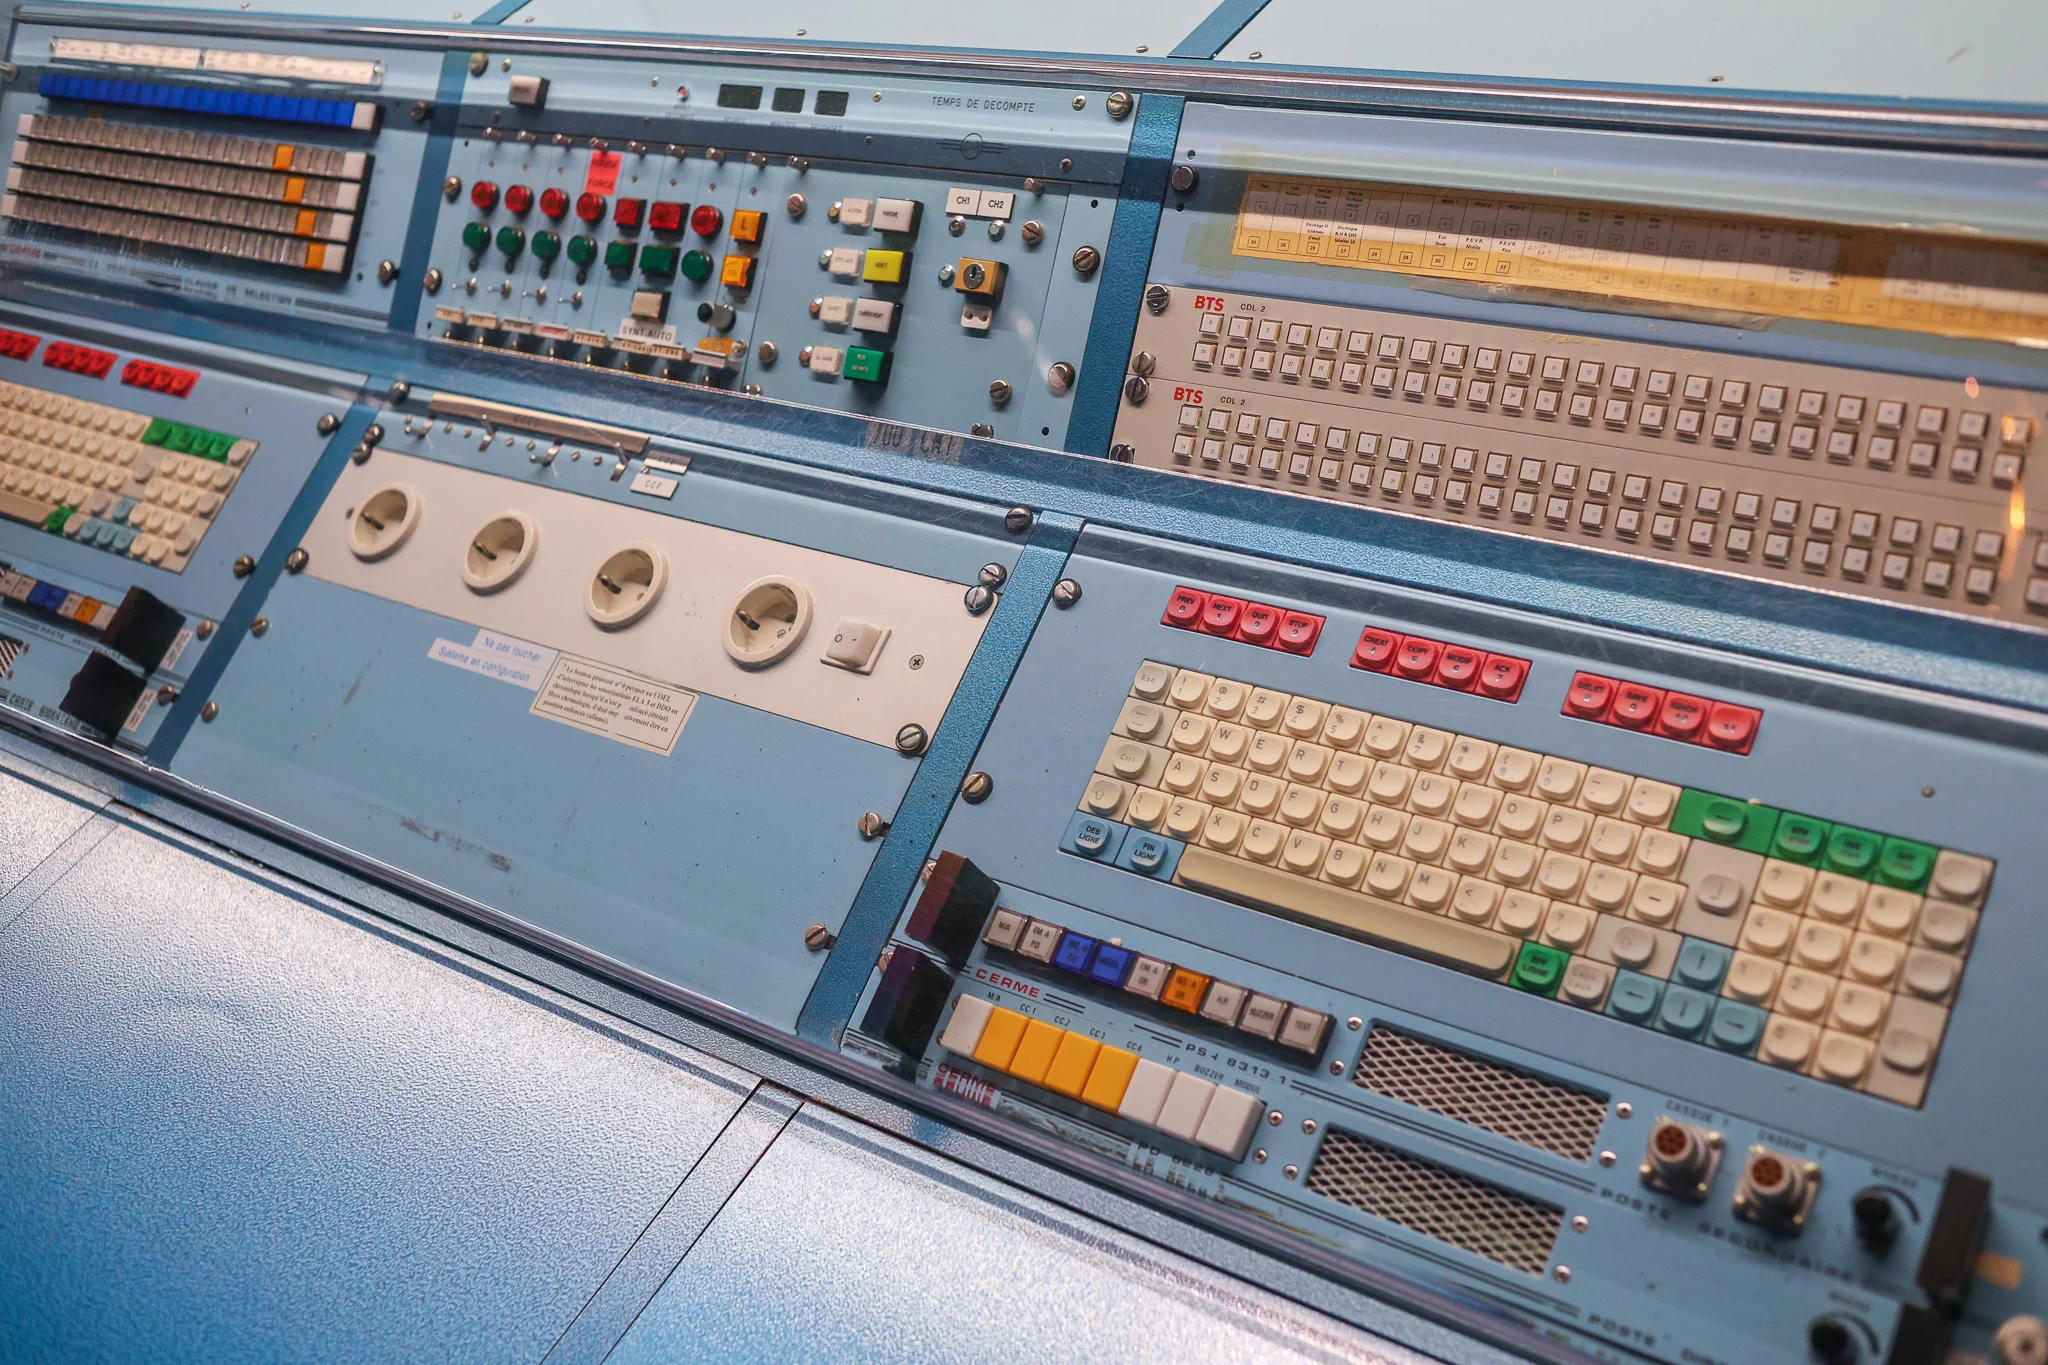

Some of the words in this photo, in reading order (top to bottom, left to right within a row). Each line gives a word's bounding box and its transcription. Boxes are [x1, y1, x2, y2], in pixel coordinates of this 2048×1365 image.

[932, 96, 961, 107] TEMPS
[966, 99, 979, 108] DE
[984, 100, 1035, 112] DECOMPTE
[956, 196, 971, 205] CH1
[988, 200, 1004, 209] CH2
[1194, 295, 1224, 312] BTS
[1240, 303, 1256, 312] CDL
[1174, 387, 1204, 404] BTS
[1220, 396, 1236, 404] CDL
[1176, 595, 1196, 605] PREV
[1212, 602, 1232, 612] NEXT
[1251, 611, 1269, 620] QUIT
[1288, 619, 1308, 628] STOP
[1364, 636, 1389, 646] CREAT
[483, 636, 495, 648] Ne
[496, 642, 511, 653] pas
[512, 646, 542, 662] toucher
[1407, 645, 1429, 655] COPY
[1446, 654, 1473, 664] MODIF
[470, 658, 481, 666] en
[481, 661, 531, 681] configuration
[1493, 664, 1511, 673] ACK
[1141, 674, 1155, 684] Esc
[626, 685, 645, 695] permet
[653, 692, 671, 703] COEL
[1213, 696, 1221, 705] 2
[656, 703, 671, 712] DDO
[1296, 705, 1304, 715] $
[1181, 720, 1189, 730] Q
[1330, 725, 1337, 734] 5
[1219, 728, 1232, 740] W
[1371, 735, 1377, 744] 6
[1256, 740, 1265, 750] E
[1414, 745, 1421, 753] 7
[1120, 754, 1135, 762] Ctrl
[1296, 749, 1305, 760] R
[1337, 760, 1345, 770] T
[1456, 756, 1463, 765] 8
[1173, 762, 1181, 771] A
[1210, 772, 1220, 782] S
[1379, 769, 1387, 780] Y
[1250, 781, 1259, 791] D
[1421, 781, 1431, 791] U
[1289, 791, 1298, 801] F
[1174, 806, 1183, 816] Z
[1330, 803, 1339, 813] G
[1213, 816, 1222, 827] X
[1371, 815, 1382, 825] H
[1552, 814, 1563, 824] P
[1086, 824, 1101, 835] DEB
[1252, 827, 1261, 837] C
[1413, 826, 1422, 835] J
[1079, 833, 1101, 844] LIGNE
[1294, 838, 1302, 848] V
[1458, 837, 1468, 848] K
[1143, 842, 1156, 852] FIN
[1134, 849, 1157, 861] LIGNE
[1334, 850, 1343, 860] B
[1501, 848, 1508, 860] L
[1376, 862, 1387, 874] N
[1418, 873, 1430, 885] M
[976, 968, 1040, 998] CERME
[987, 992, 1001, 1003] M/A
[1194, 1063, 1225, 1081] BUZZER
[1234, 1078, 1261, 1094] MODUL
